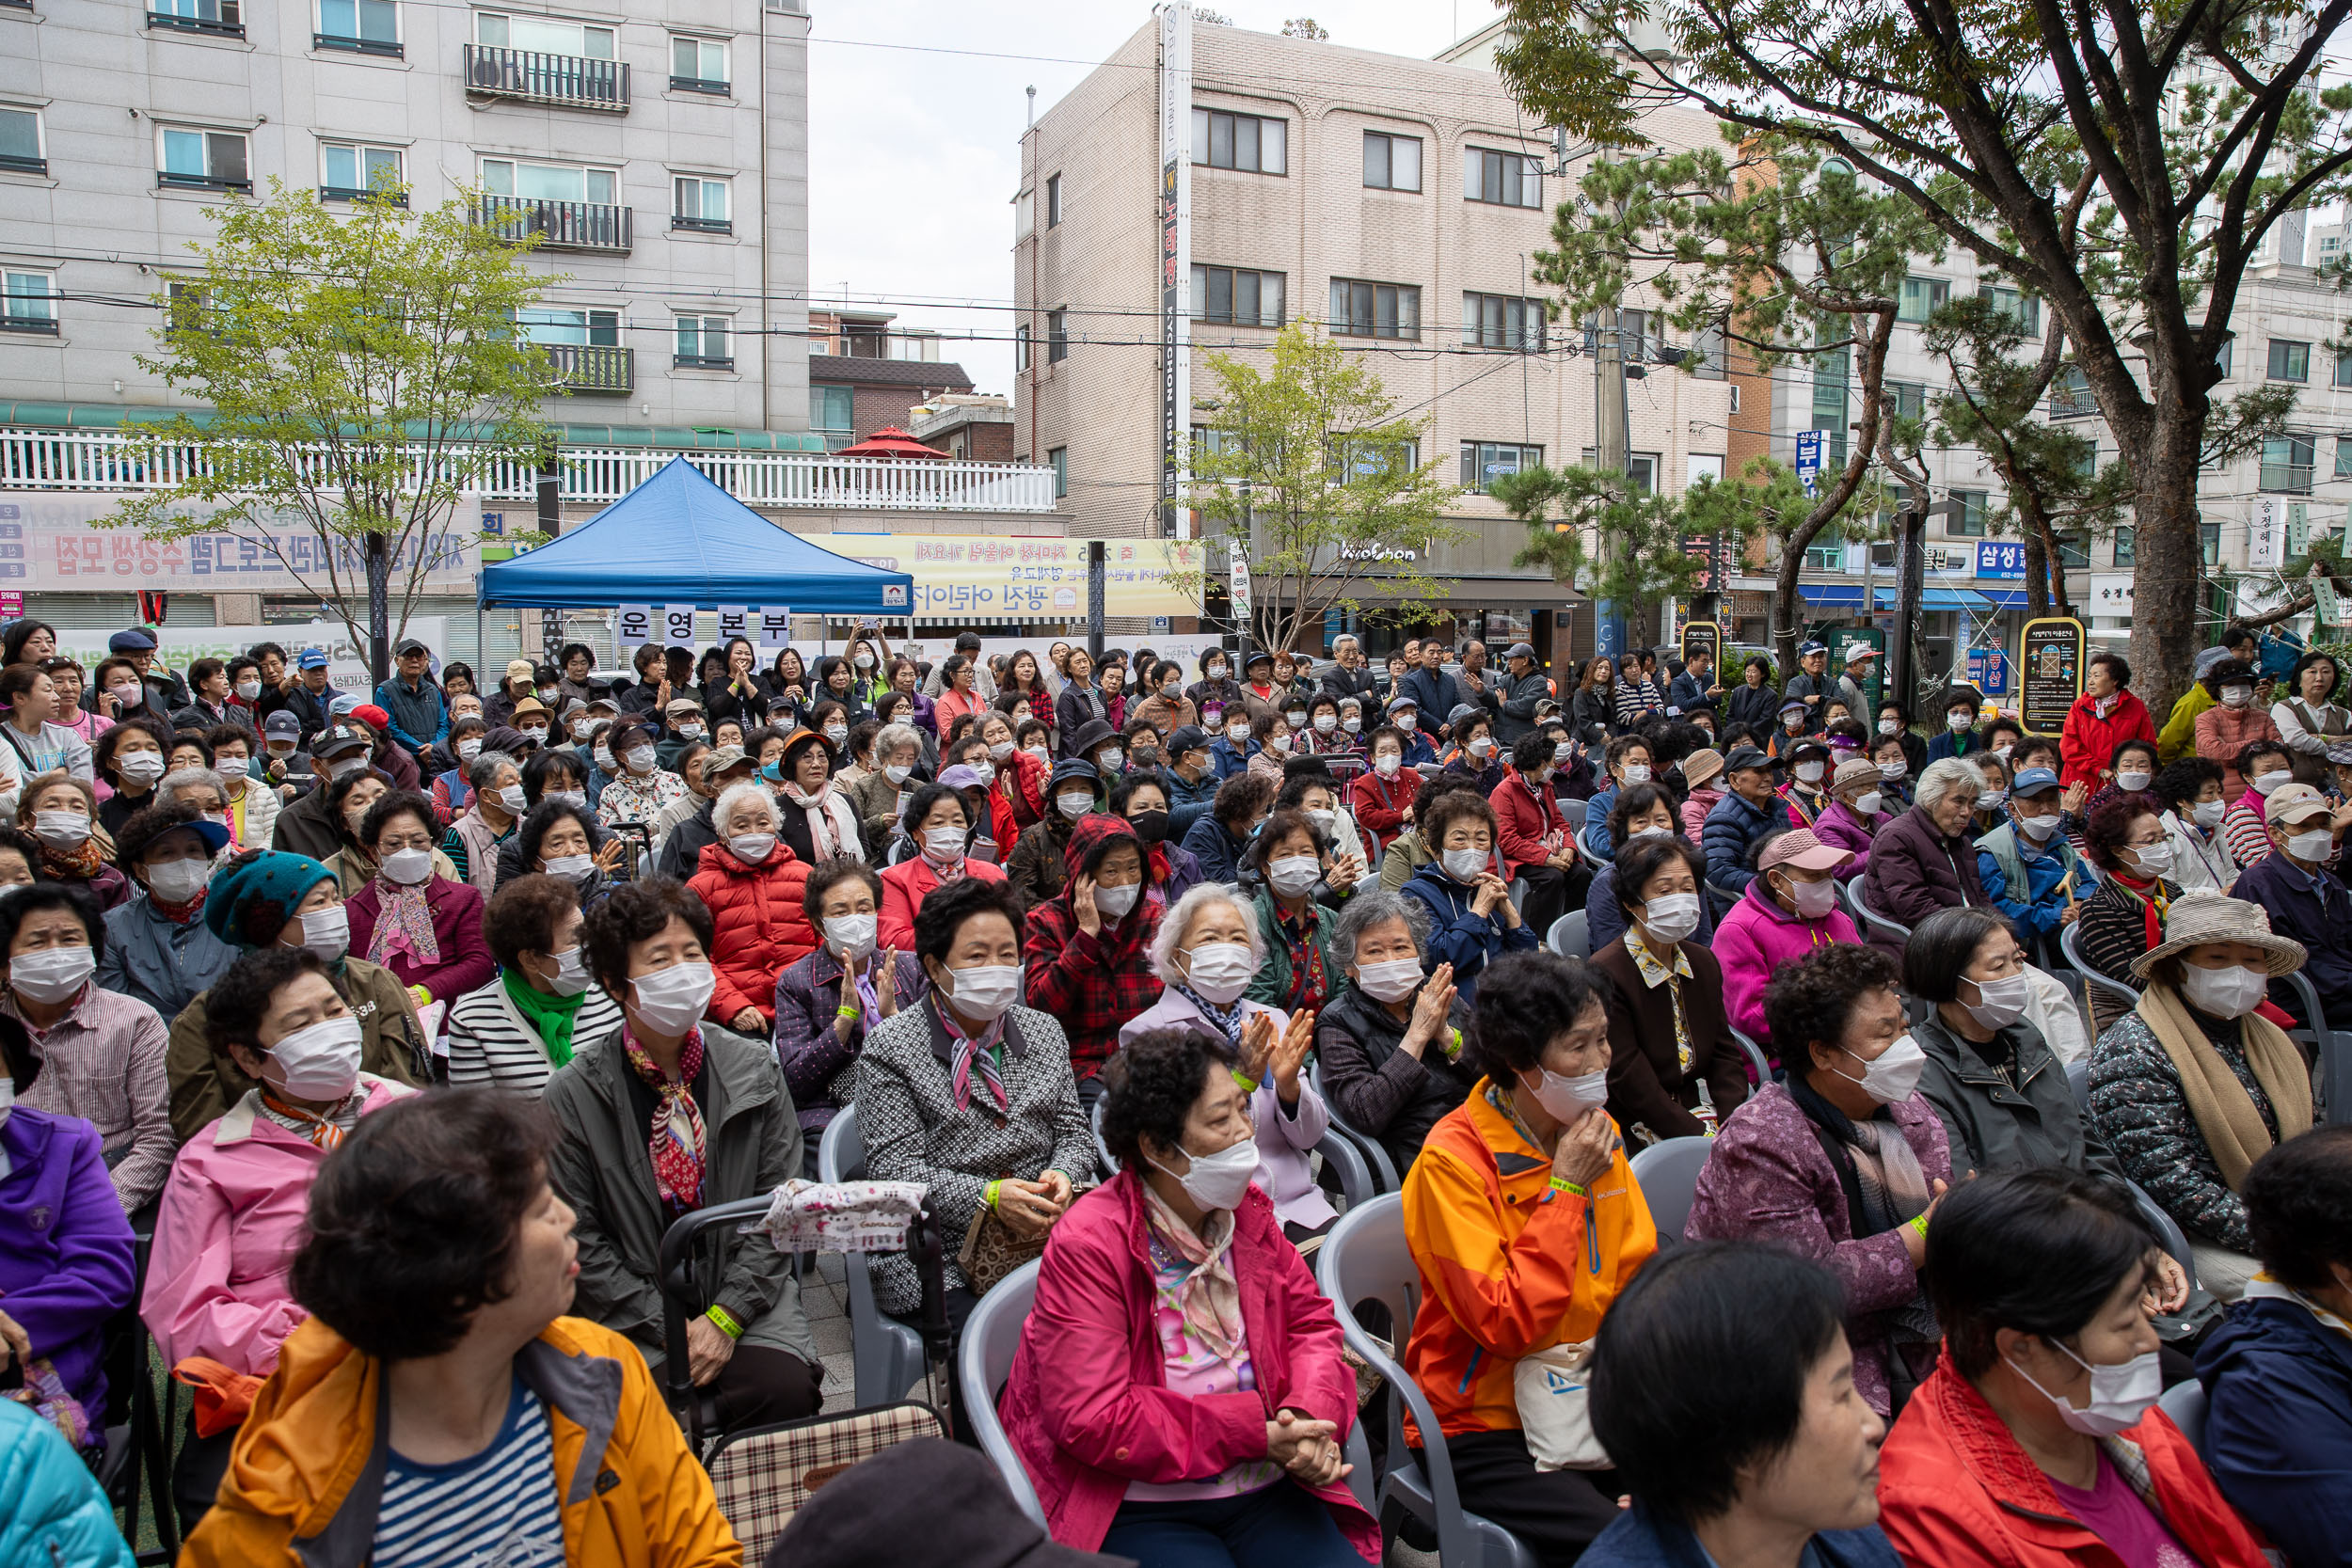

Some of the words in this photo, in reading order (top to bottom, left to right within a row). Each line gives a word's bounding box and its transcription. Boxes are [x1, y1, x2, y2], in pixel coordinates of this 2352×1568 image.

[1167, 170, 1175, 191] W
[1800, 431, 1820, 445] 삼성
[1981, 546, 2015, 569] 삼성
